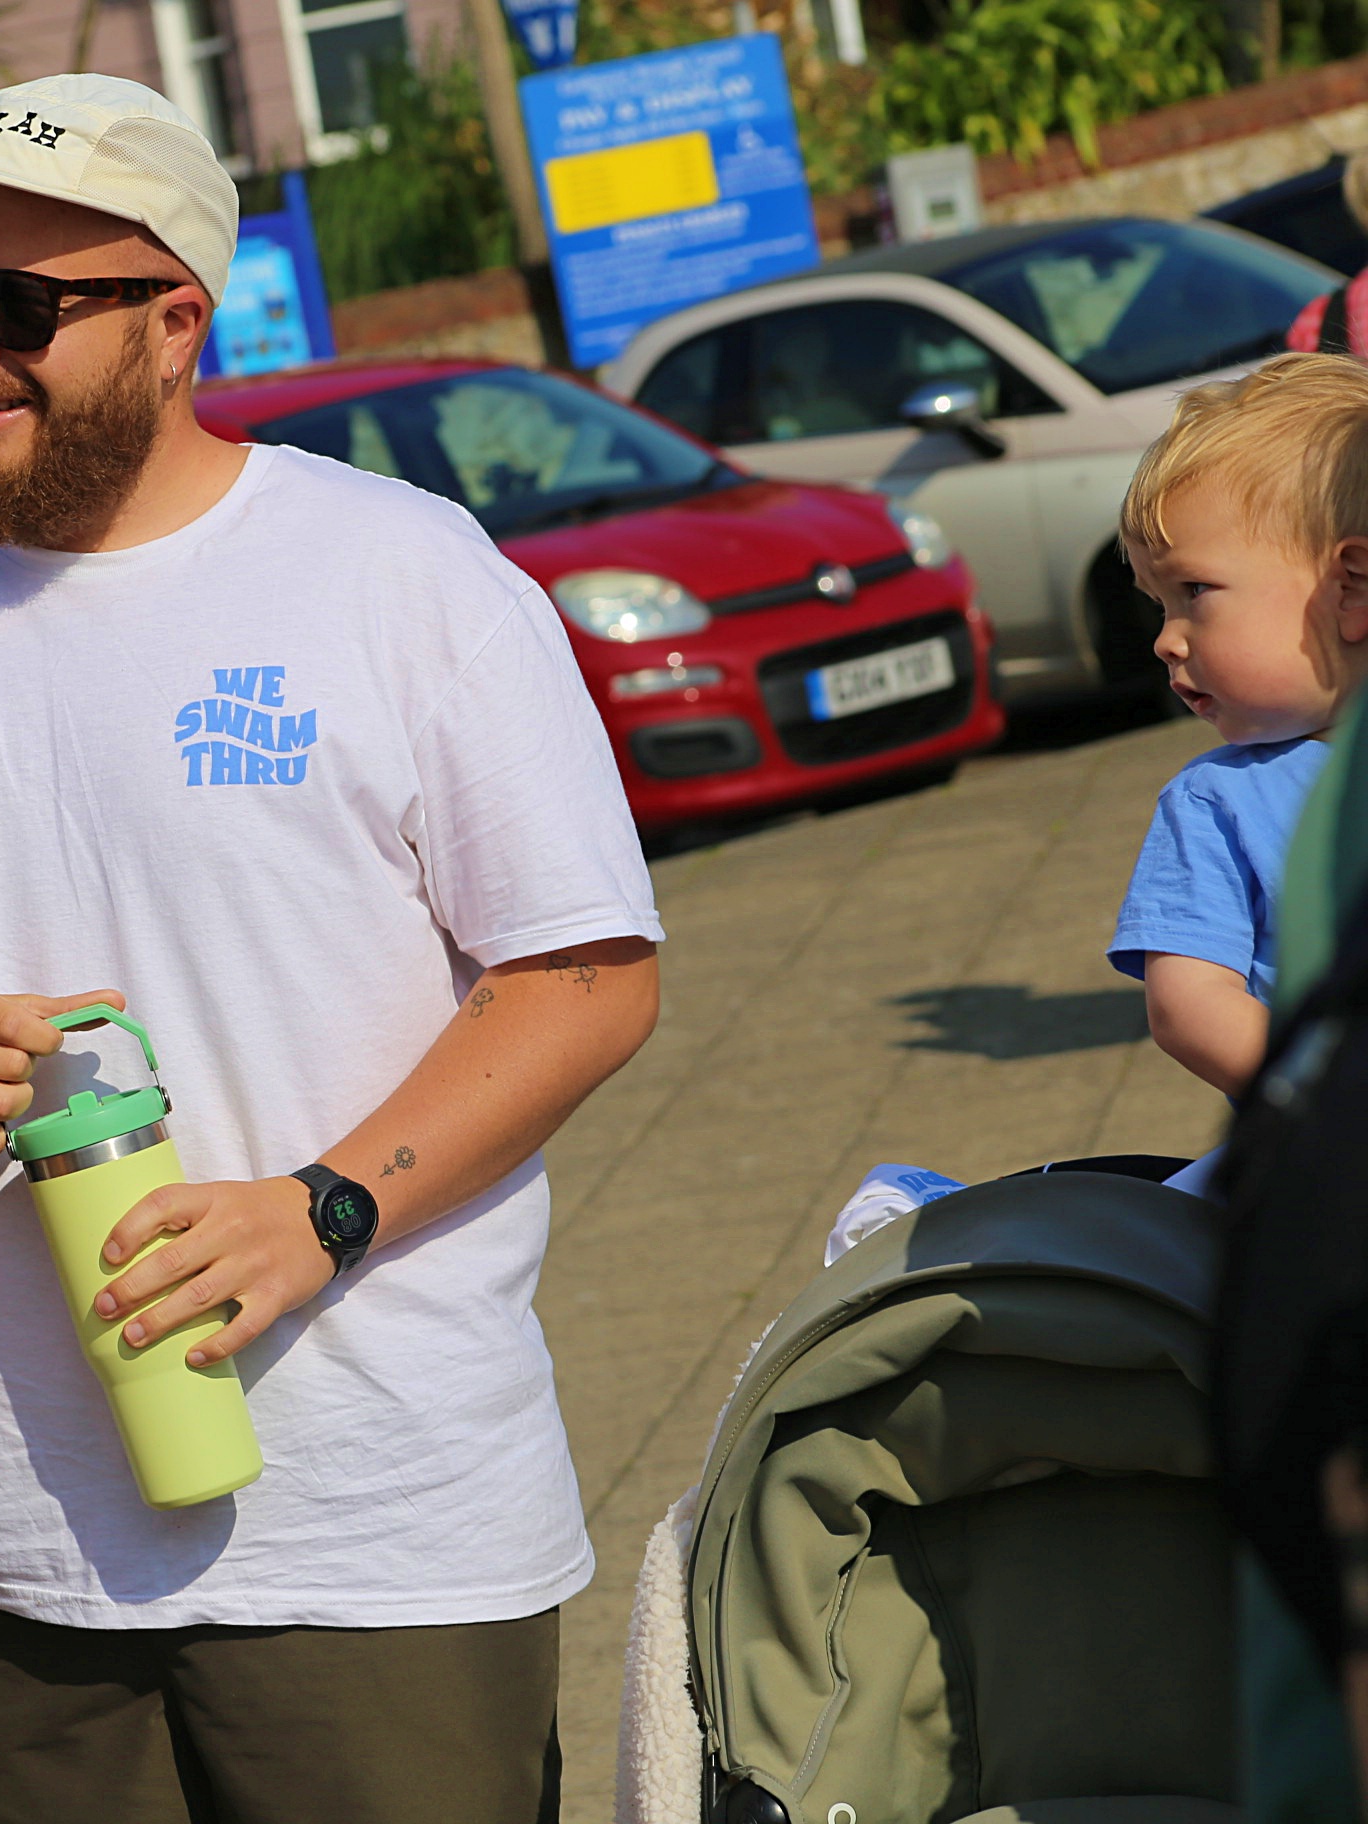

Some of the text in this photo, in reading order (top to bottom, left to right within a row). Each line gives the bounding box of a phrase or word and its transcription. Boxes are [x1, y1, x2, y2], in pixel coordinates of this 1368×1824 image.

[212, 666, 285, 708] WE
[174, 698, 318, 753] SWAM
[181, 740, 308, 787] THRU
